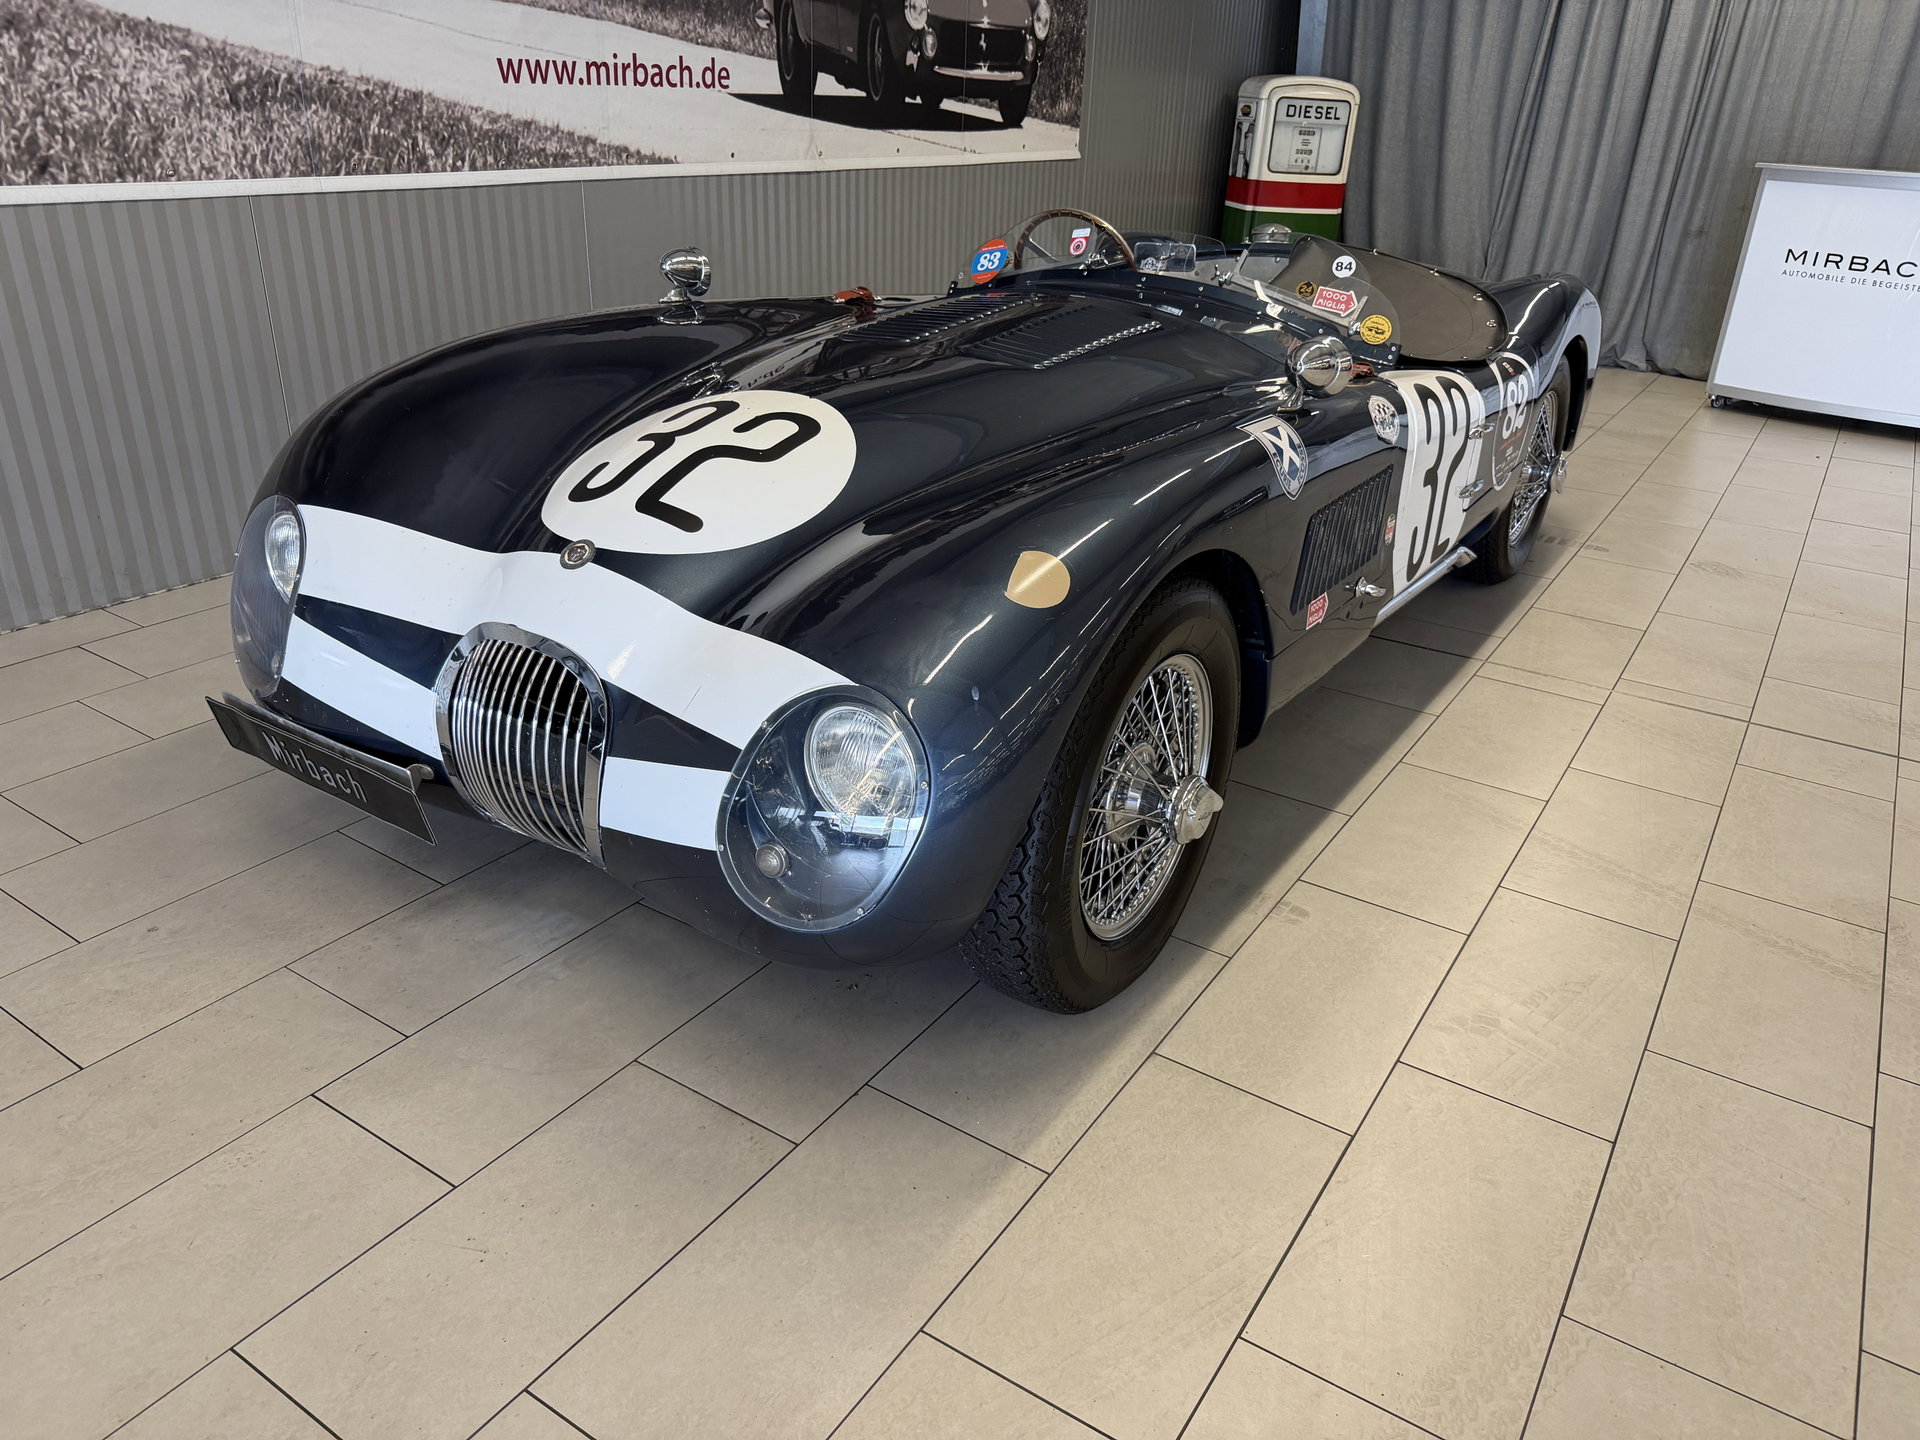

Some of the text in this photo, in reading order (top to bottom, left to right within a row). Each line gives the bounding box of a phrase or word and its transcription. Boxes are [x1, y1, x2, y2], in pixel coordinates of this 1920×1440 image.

[496, 52, 731, 90] www.mirbach.de
[1285, 104, 1341, 121] DIESEL
[977, 251, 1001, 271] 83
[1335, 261, 1353, 272] 84
[1784, 248, 1919, 278] MIRBAC
[1781, 269, 1846, 283] AUTOMOBILE
[1850, 277, 1868, 286] DIE
[1316, 298, 1346, 311] MIGLIA
[1322, 290, 1348, 302] 1000
[1502, 374, 1529, 440] 82
[567, 400, 822, 533] 32
[1406, 375, 1471, 583] 32
[261, 729, 368, 804] Mirbach
